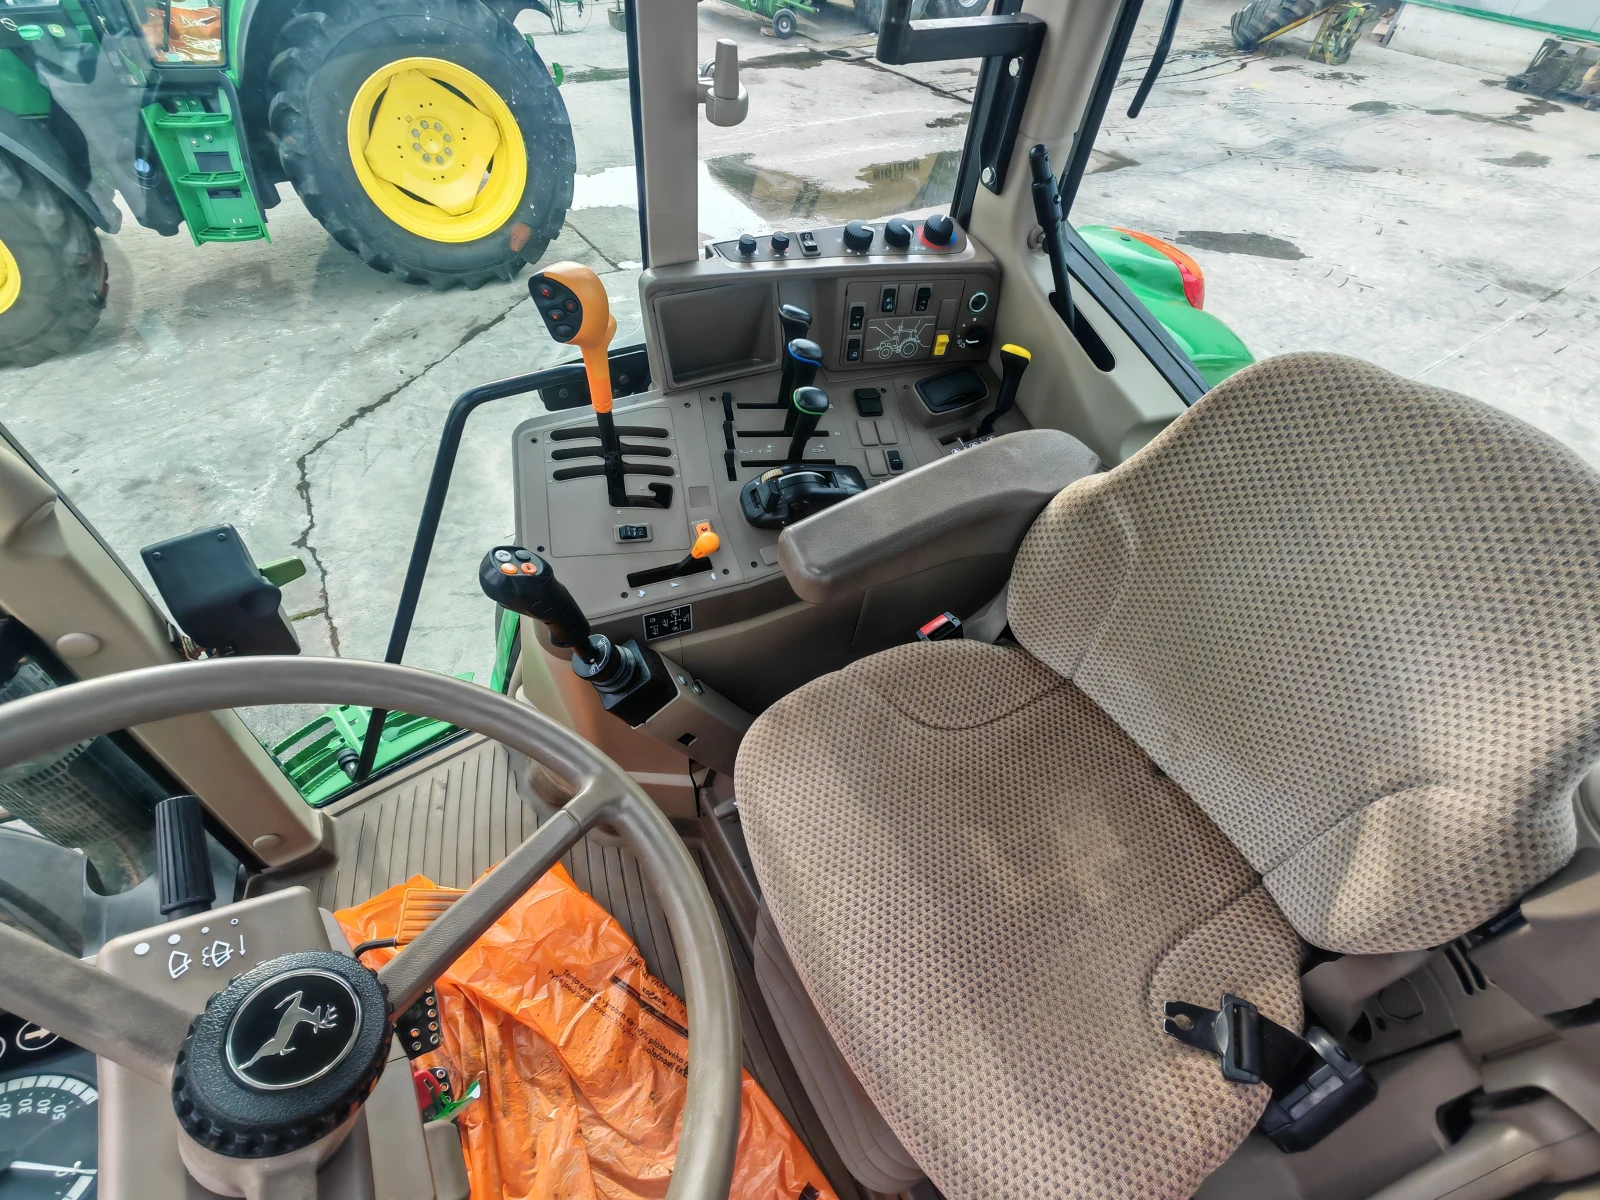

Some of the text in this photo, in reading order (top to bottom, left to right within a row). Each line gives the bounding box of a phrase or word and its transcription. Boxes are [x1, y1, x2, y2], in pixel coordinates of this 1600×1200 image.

[547, 969, 563, 984] Pytle
[561, 982, 576, 994] jsou
[562, 969, 580, 984] Tento
[648, 1037, 684, 1064] plastového
[18, 1098, 33, 1115] 30
[37, 1099, 51, 1115] 40
[52, 1104, 67, 1120] 50
